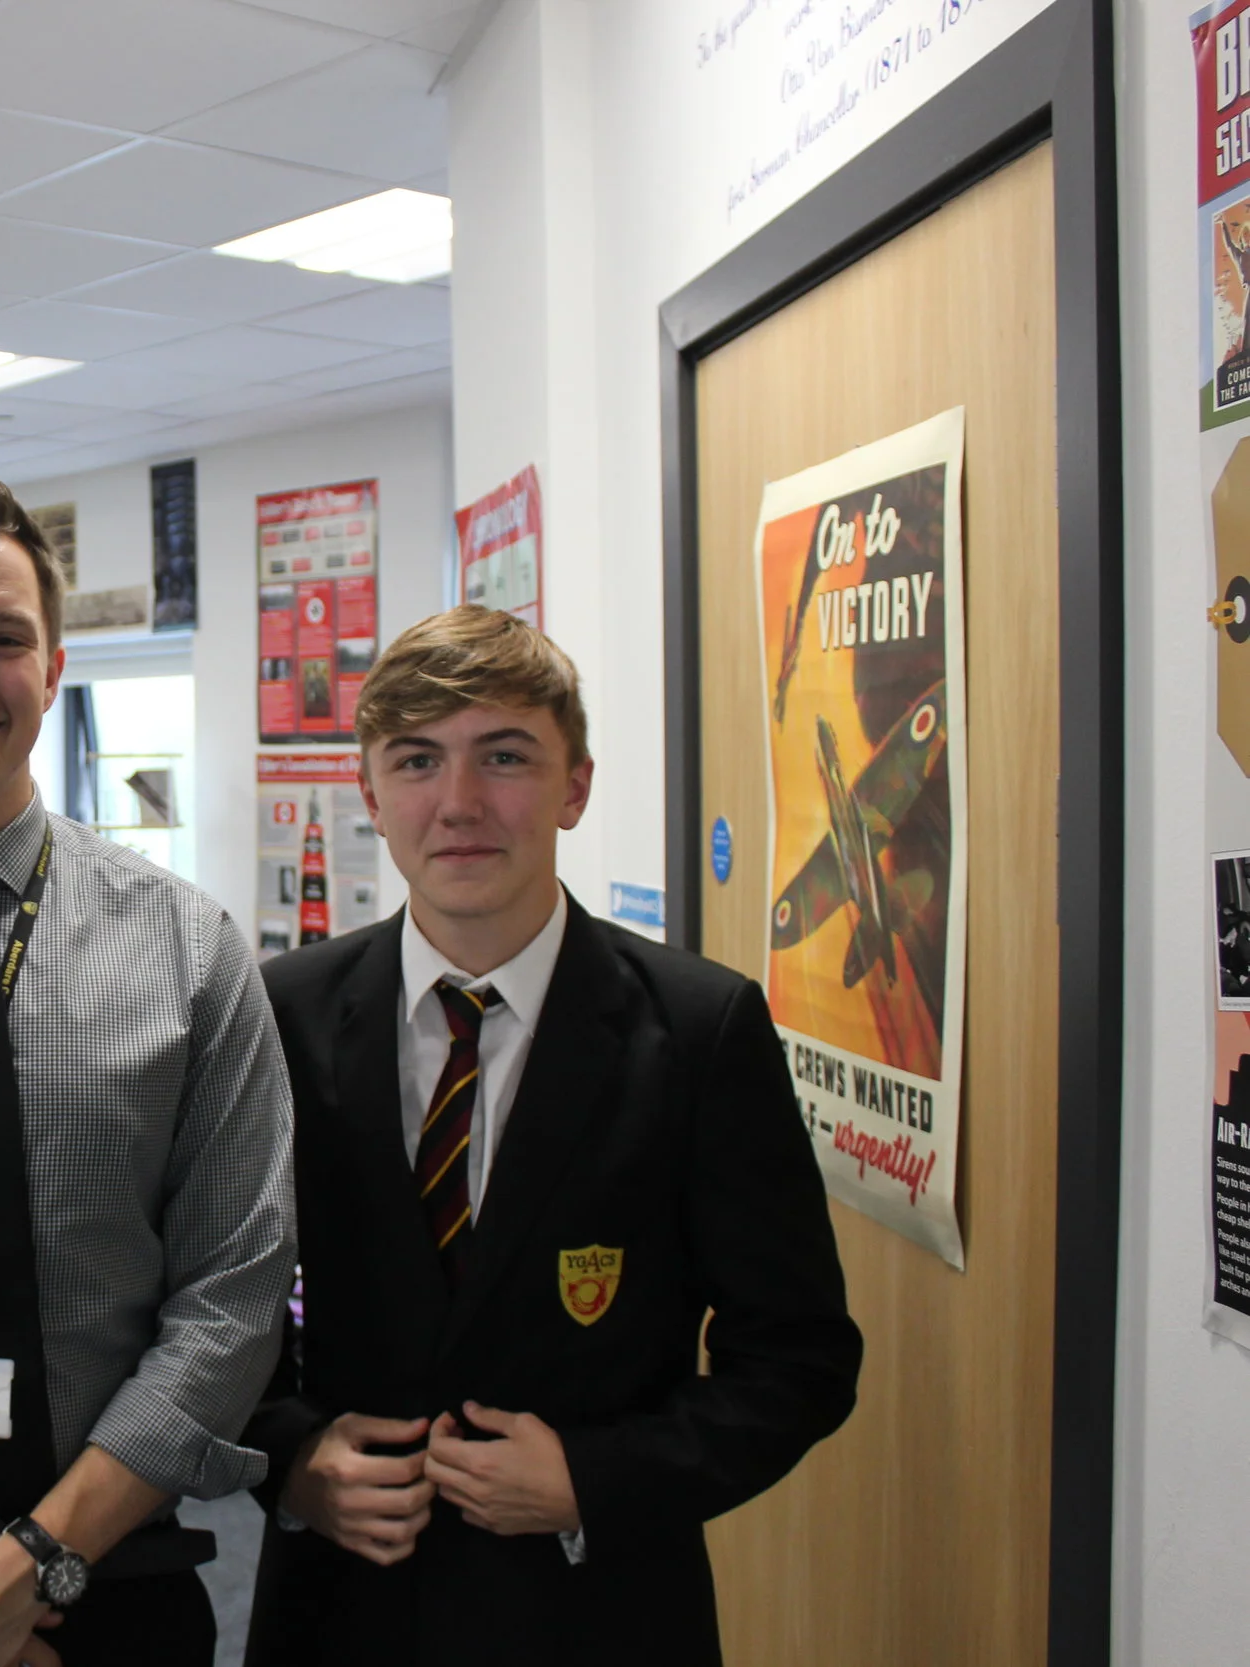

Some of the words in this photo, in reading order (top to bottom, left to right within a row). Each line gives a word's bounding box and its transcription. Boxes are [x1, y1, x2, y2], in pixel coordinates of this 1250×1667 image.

[916, 22, 933, 52] to
[1219, 385, 1236, 402] THE
[816, 503, 857, 571] On
[865, 493, 901, 558] to
[817, 571, 934, 652] VICTORY
[795, 1042, 847, 1099] CREWS
[853, 1064, 935, 1135] WANTED
[833, 1119, 938, 1207] urgently!
[1216, 1156, 1237, 1172] Sirens
[1216, 1174, 1230, 1188] way
[1230, 1178, 1239, 1189] to
[1216, 1191, 1239, 1209] People
[1216, 1209, 1237, 1226] cheap
[1217, 1228, 1240, 1246] People
[1234, 1265, 1245, 1280] for
[1220, 1278, 1241, 1295] arches
